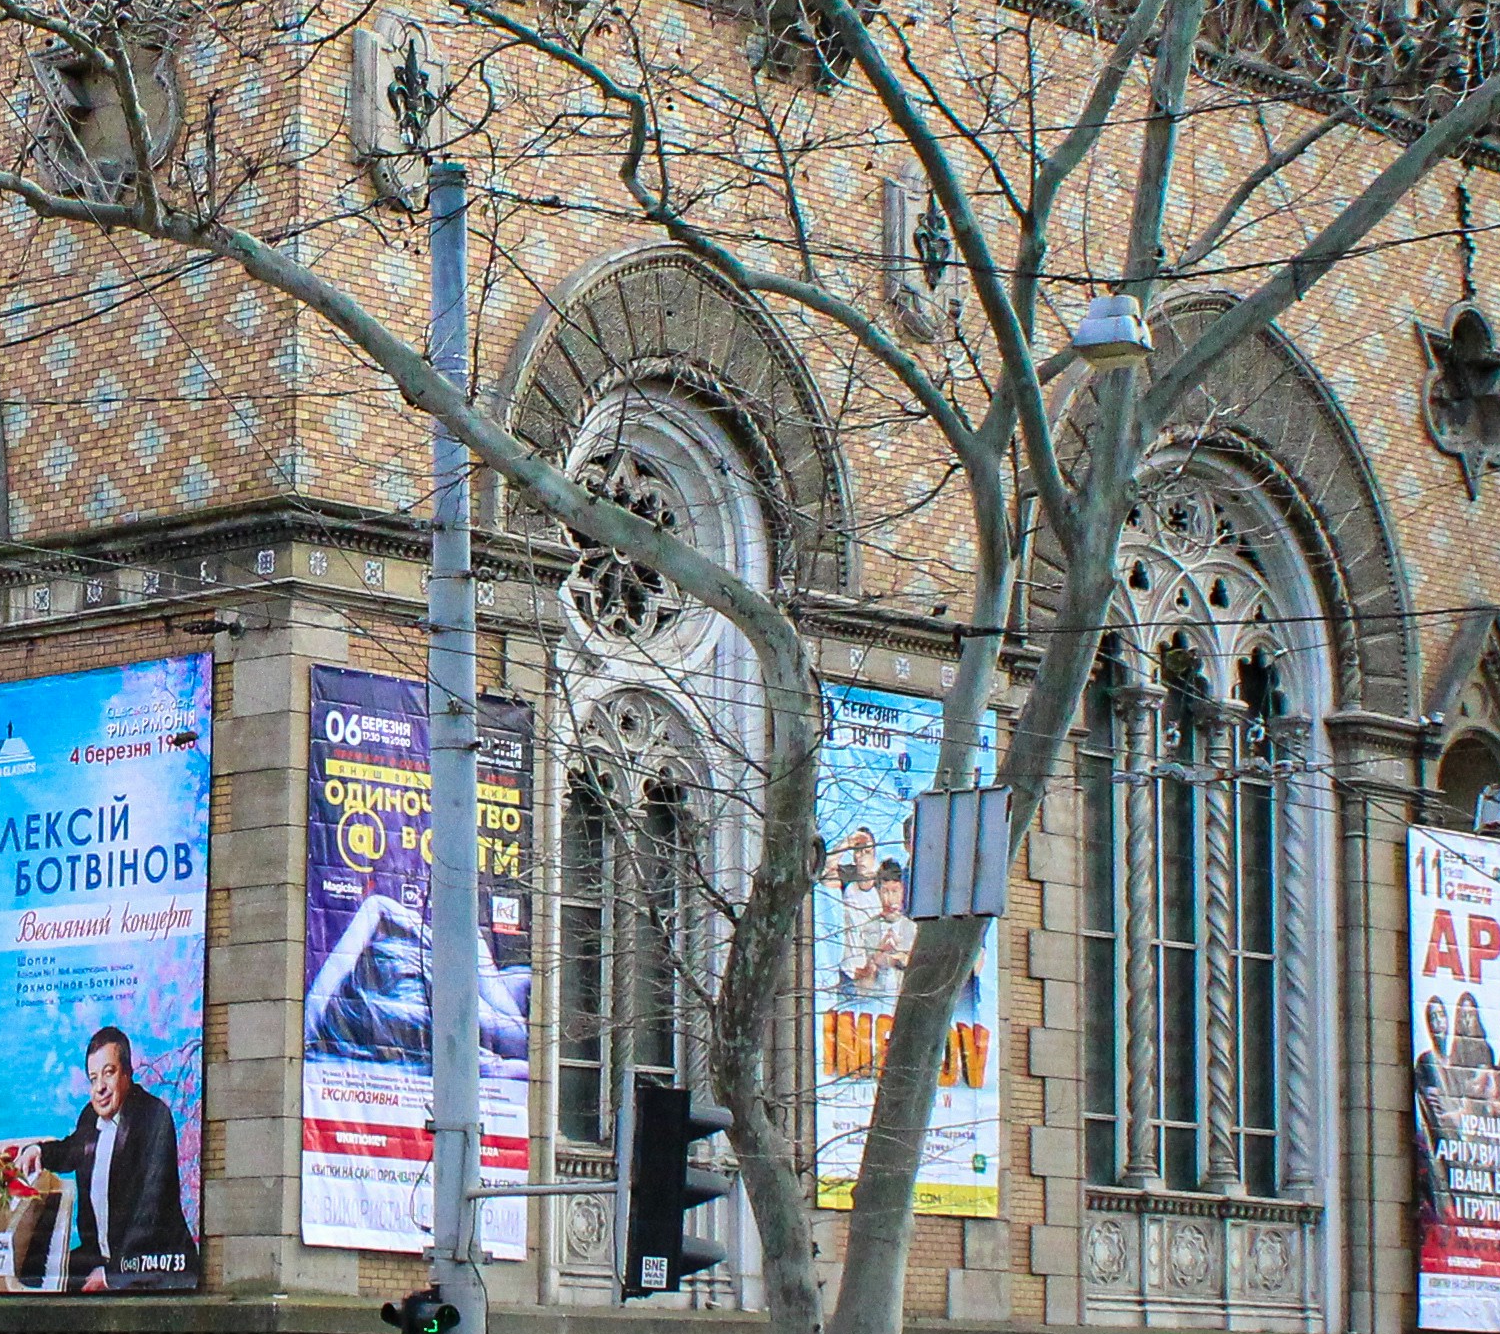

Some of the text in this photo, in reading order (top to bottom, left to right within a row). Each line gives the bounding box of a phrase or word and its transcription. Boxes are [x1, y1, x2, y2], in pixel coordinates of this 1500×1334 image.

[106, 710, 196, 739] ФІЛАРМОНІЯ
[325, 710, 362, 747] 06
[361, 715, 412, 737] БЕРЕЗНЯ
[69, 746, 80, 766] 4
[84, 741, 151, 766] березня
[337, 765, 383, 780] ЯНУШ
[14, 842, 194, 897] БОТВІНОВ
[1415, 845, 1442, 899] 11
[15, 896, 194, 944] Весняний концерт
[321, 1087, 400, 1108] ЕКСКЛЮЗИВНА
[1468, 1144, 1480, 1164] У
[1449, 1167, 1493, 1194] ІВАНА
[120, 1253, 186, 1274] (048) 704 07 33
[644, 1258, 666, 1272] BNE
[644, 1271, 665, 1279] WAS
